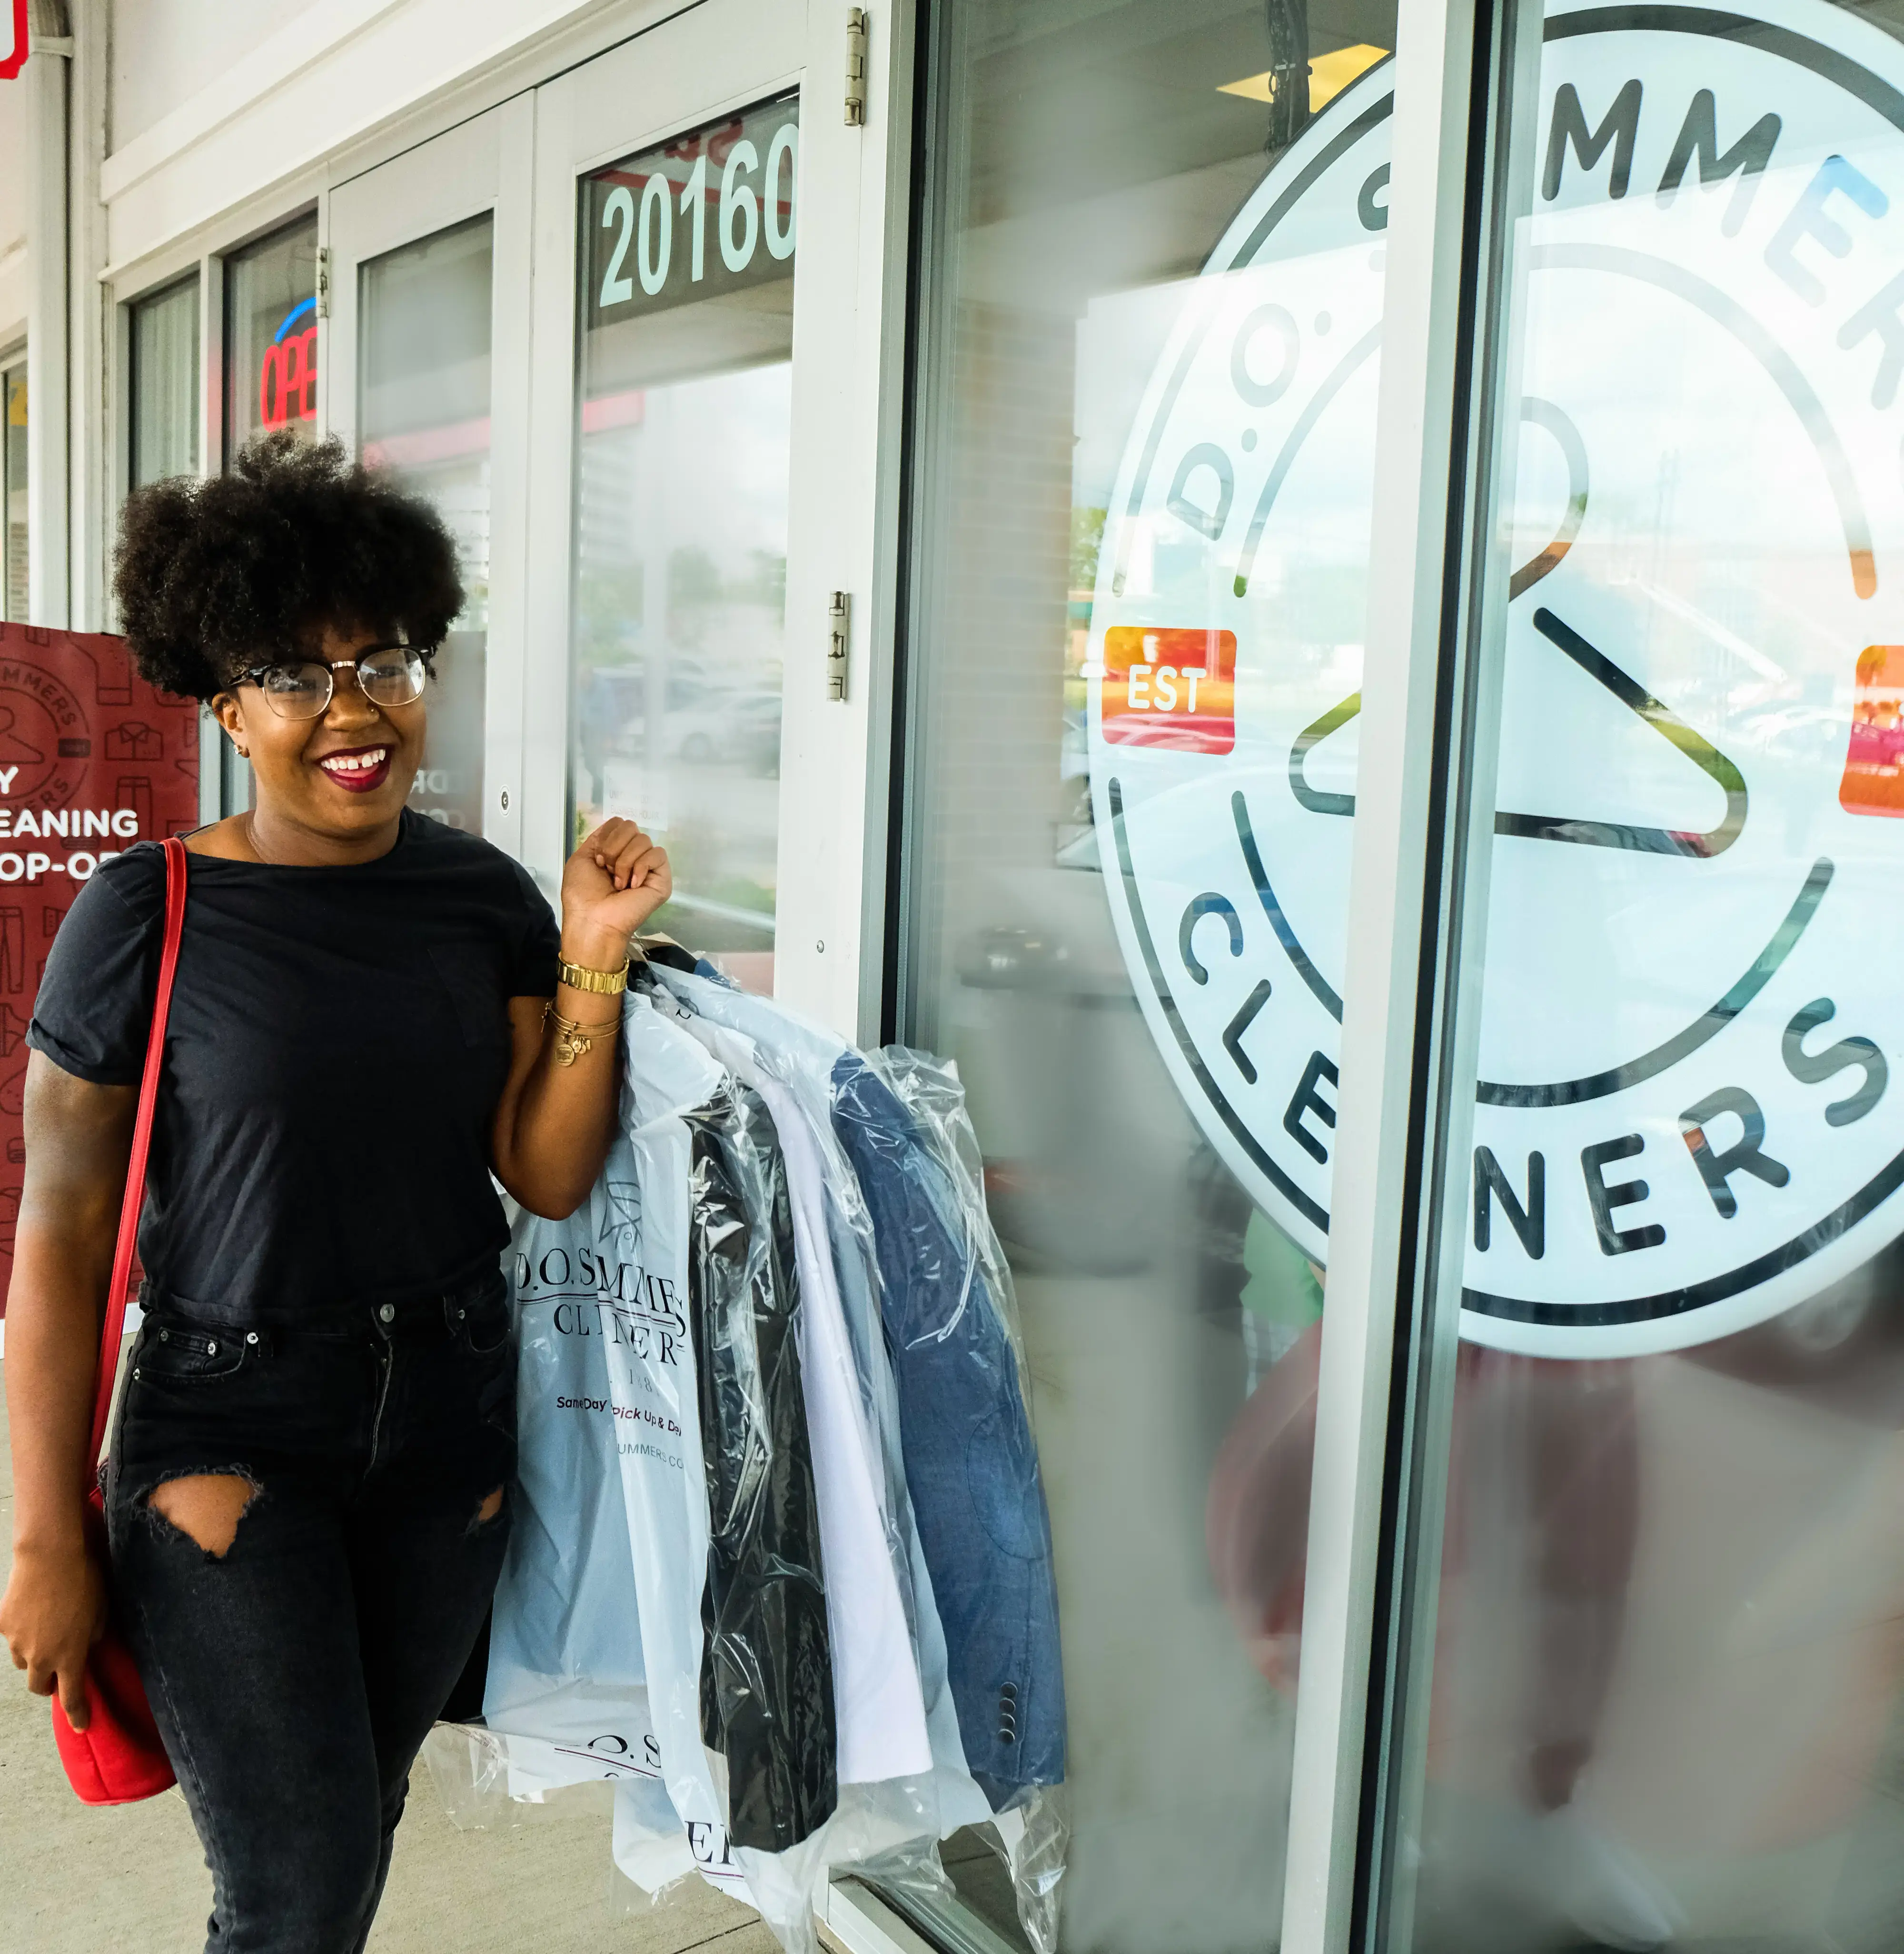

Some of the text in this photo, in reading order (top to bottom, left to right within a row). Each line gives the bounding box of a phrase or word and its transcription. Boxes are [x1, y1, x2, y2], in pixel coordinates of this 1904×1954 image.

[600, 123, 799, 307] 20160
[260, 326, 317, 433] OPE
[2, 666, 76, 725] MMERS
[1128, 664, 1207, 713] EST
[0, 809, 139, 838] EANING
[1179, 892, 1888, 1260] CLENERS
